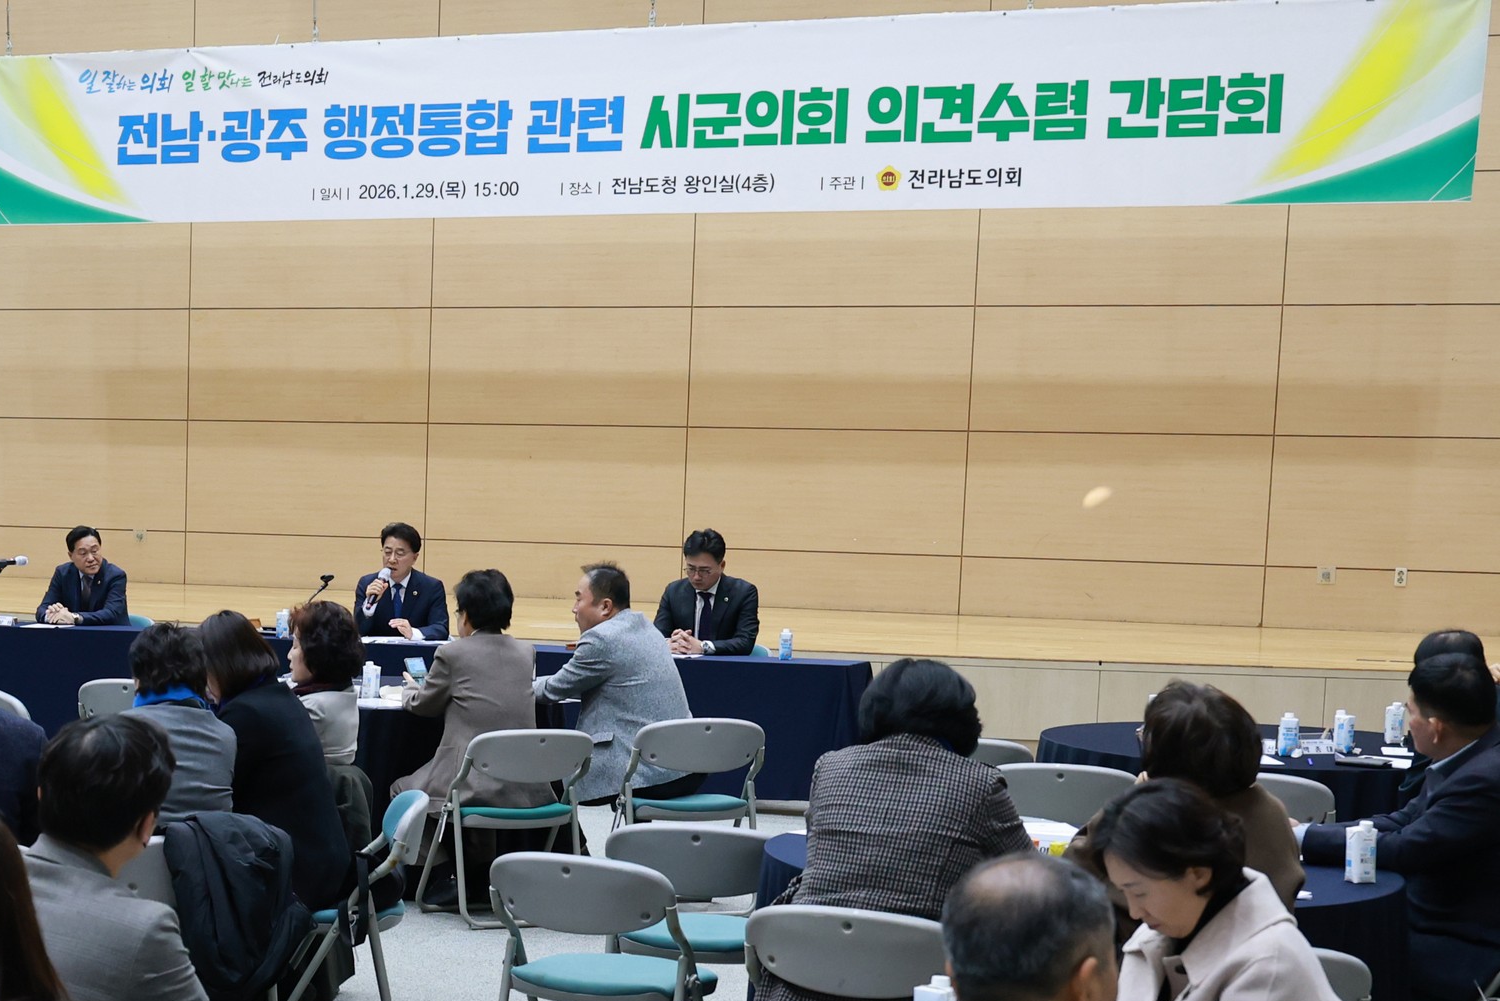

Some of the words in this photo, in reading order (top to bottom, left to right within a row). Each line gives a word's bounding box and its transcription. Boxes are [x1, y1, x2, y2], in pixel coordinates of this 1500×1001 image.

[140, 68, 174, 94] 의회
[257, 67, 330, 88] 전라남도의회
[324, 99, 513, 160] 행정통합
[527, 96, 625, 154] 관련
[640, 87, 849, 149] 시군의회
[865, 79, 1089, 143] 의견수렴
[1107, 72, 1285, 139] 간담회
[611, 176, 677, 195] 전남도청
[684, 173, 775, 194] 왕인실(4층)
[908, 167, 1022, 190] 전라남도의회
[359, 181, 467, 200] 2026.1.29.(목)
[474, 181, 519, 198] 15:00
